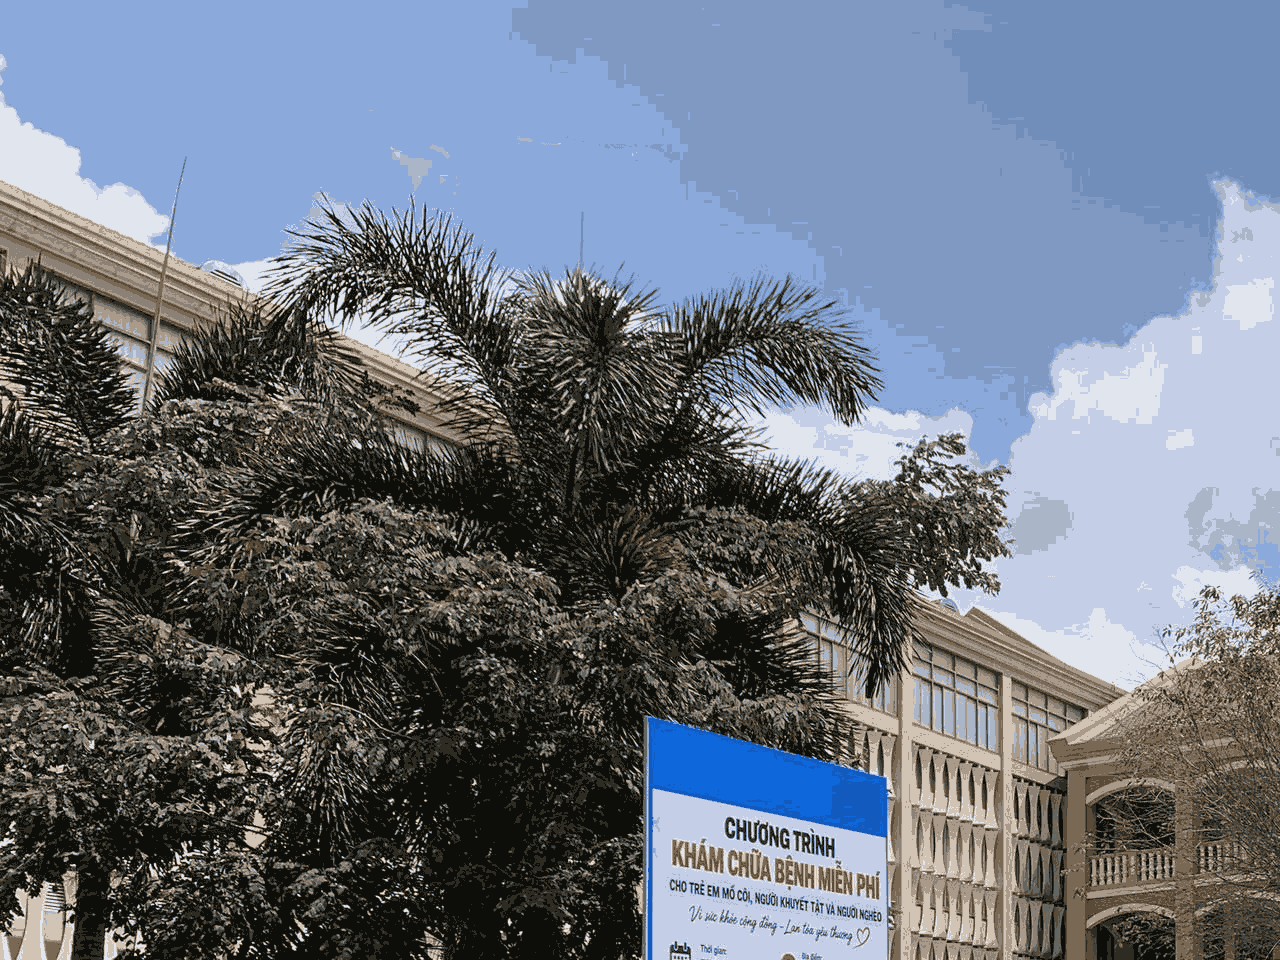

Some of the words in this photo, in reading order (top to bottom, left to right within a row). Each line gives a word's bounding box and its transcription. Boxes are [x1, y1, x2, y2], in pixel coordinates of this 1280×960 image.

[724, 816, 790, 850] CHƯƠNG
[793, 828, 835, 859] TRÌNH
[671, 838, 725, 874] KHÁM
[727, 848, 772, 882] CHỮA
[774, 854, 815, 891] BỆNH
[818, 859, 853, 896] MIỄN
[856, 870, 881, 901] PHÍ
[669, 878, 687, 893] CHO
[689, 879, 705, 896] TRẺ
[707, 884, 720, 898] EM
[755, 891, 779, 907] NGƯỜI
[780, 895, 809, 912] KHUYẾT
[810, 899, 824, 916] TẬT
[826, 901, 835, 915] VÀ
[837, 904, 858, 919] NGƯỜI
[860, 907, 882, 922] NGHÈO
